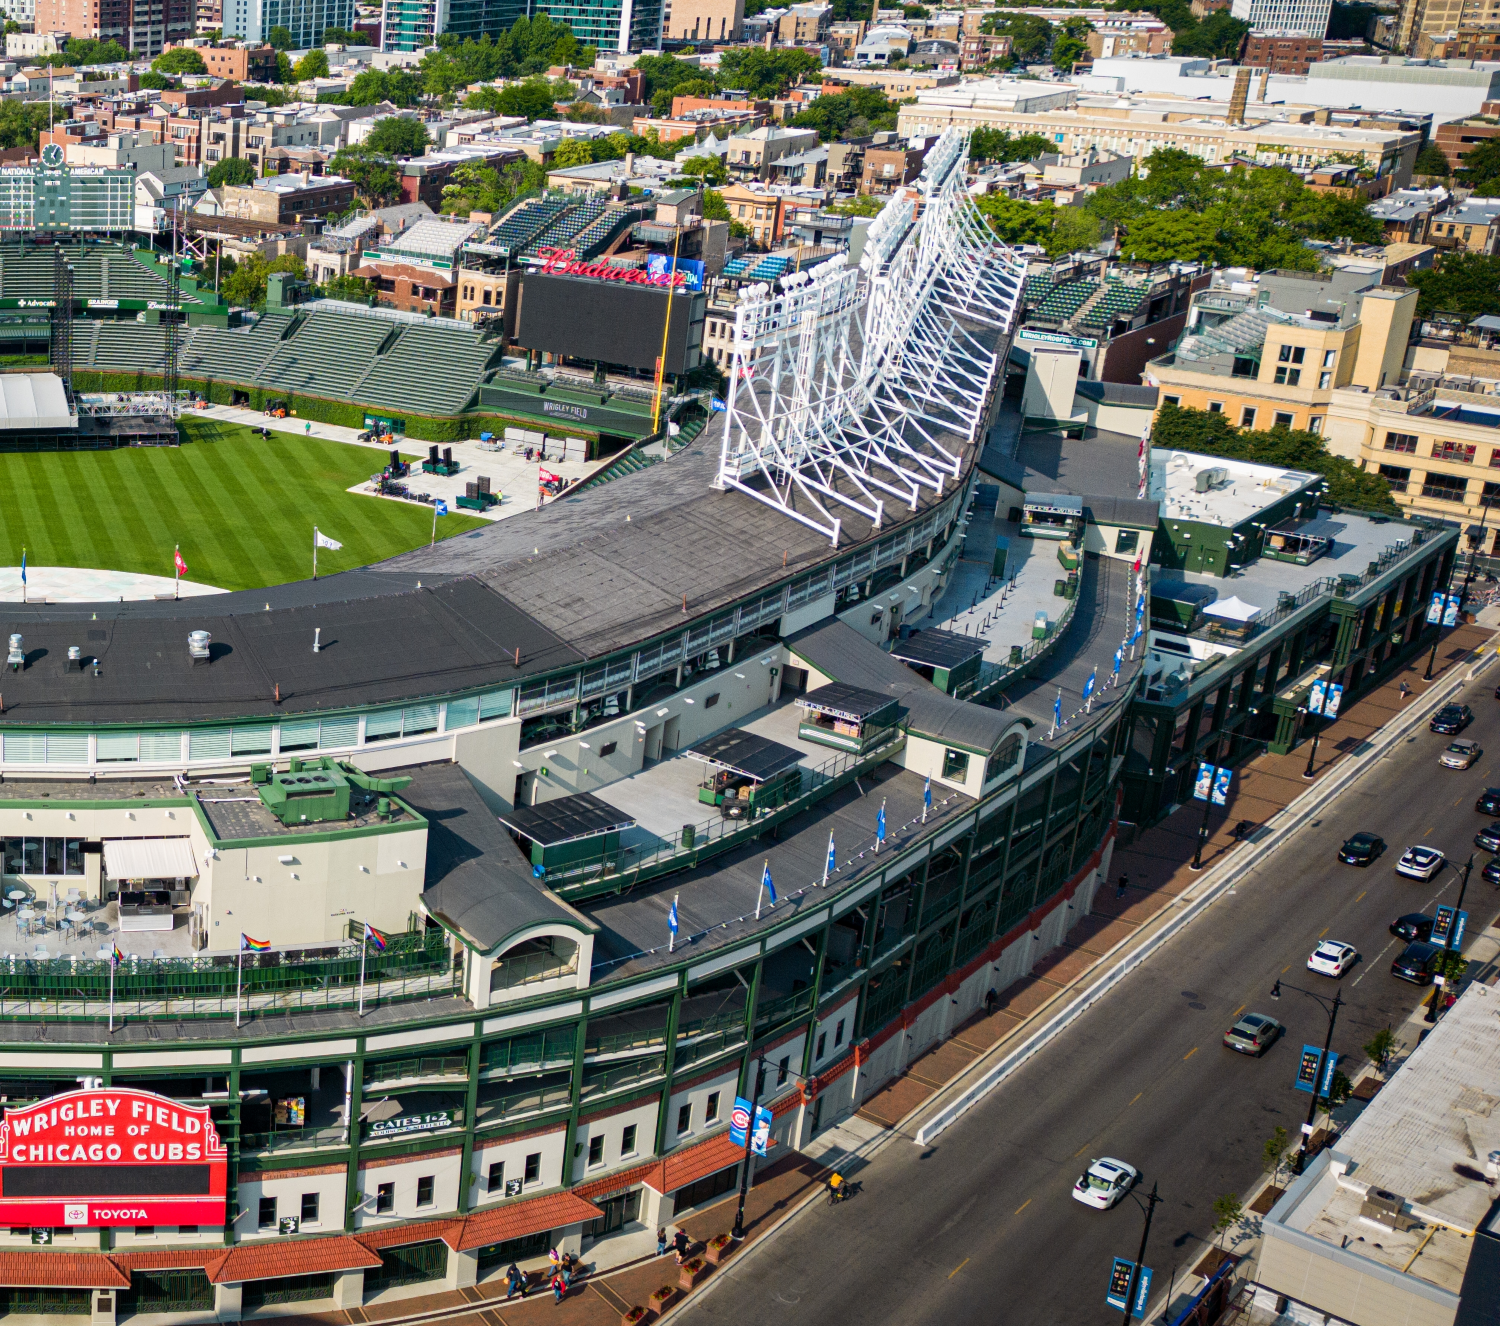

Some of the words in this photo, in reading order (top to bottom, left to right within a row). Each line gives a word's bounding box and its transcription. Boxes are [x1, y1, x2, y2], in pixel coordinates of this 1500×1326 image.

[1, 168, 36, 176] NATIONAL
[70, 168, 104, 176] AMERICAN
[537, 247, 688, 287] Budweiser
[1022, 331, 1094, 347] WRIGLEYROOFTOPS.COM
[543, 401, 570, 414] WRIGLEY
[571, 406, 587, 419] FIELD
[12, 1098, 121, 1137] WRIGLEY
[132, 1100, 201, 1135] FIELD
[372, 1116, 422, 1130] GATES
[64, 1125, 115, 1137] HOME
[127, 1125, 151, 1136] OF
[12, 1143, 122, 1162] CHICAGO
[133, 1142, 201, 1160] CUBS
[511, 1181, 520, 1193] 3
[93, 1209, 148, 1219] TOYOTA
[285, 1220, 296, 1232] 3
[35, 1230, 49, 1242] 3
